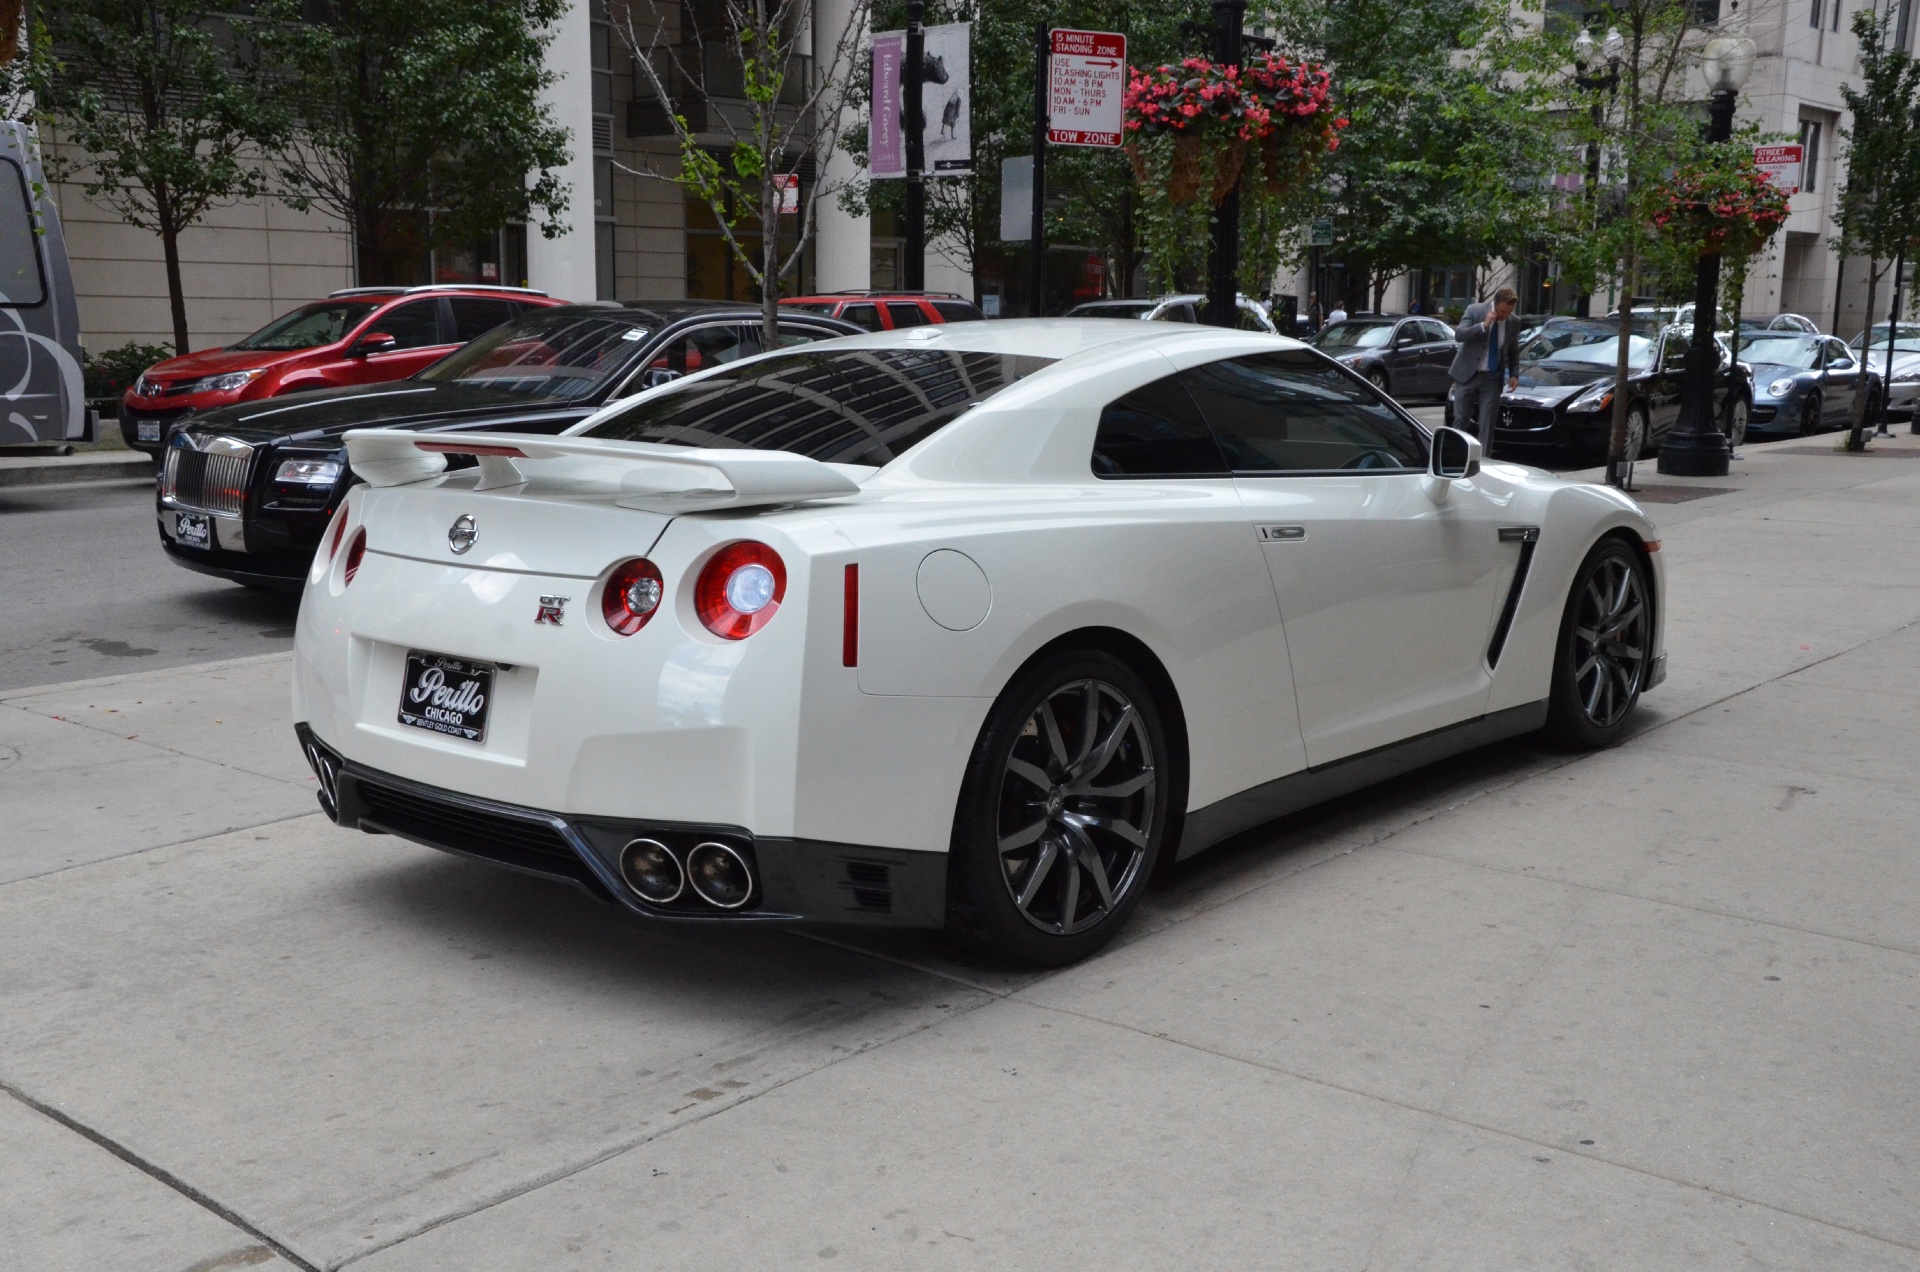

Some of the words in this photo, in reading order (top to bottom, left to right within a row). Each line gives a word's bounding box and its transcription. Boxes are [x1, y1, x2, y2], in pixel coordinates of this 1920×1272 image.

[1056, 33, 1063, 42] 15
[1066, 34, 1094, 44] MINUTE
[1056, 44, 1092, 54] STANDING
[1097, 46, 1117, 56] ZONE
[1055, 58, 1070, 67] USE
[883, 54, 893, 104] Edward
[1054, 68, 1092, 78] FLASHING
[1094, 71, 1120, 80] LIGHTS
[1080, 88, 1106, 98] THURS
[1053, 130, 1078, 142] TOW
[1084, 133, 1115, 144] ZONE
[1757, 148, 1786, 156] STREET
[1756, 155, 1796, 163] CLEANING
[178, 518, 207, 538] Perillo
[539, 594, 571, 606] GT
[434, 658, 463, 671] Perillo
[410, 668, 484, 715] Perillo
[425, 706, 463, 725] CHICAGO
[416, 719, 435, 729] BENTLEY
[435, 722, 447, 732] GOLD
[448, 726, 462, 735] COAST
